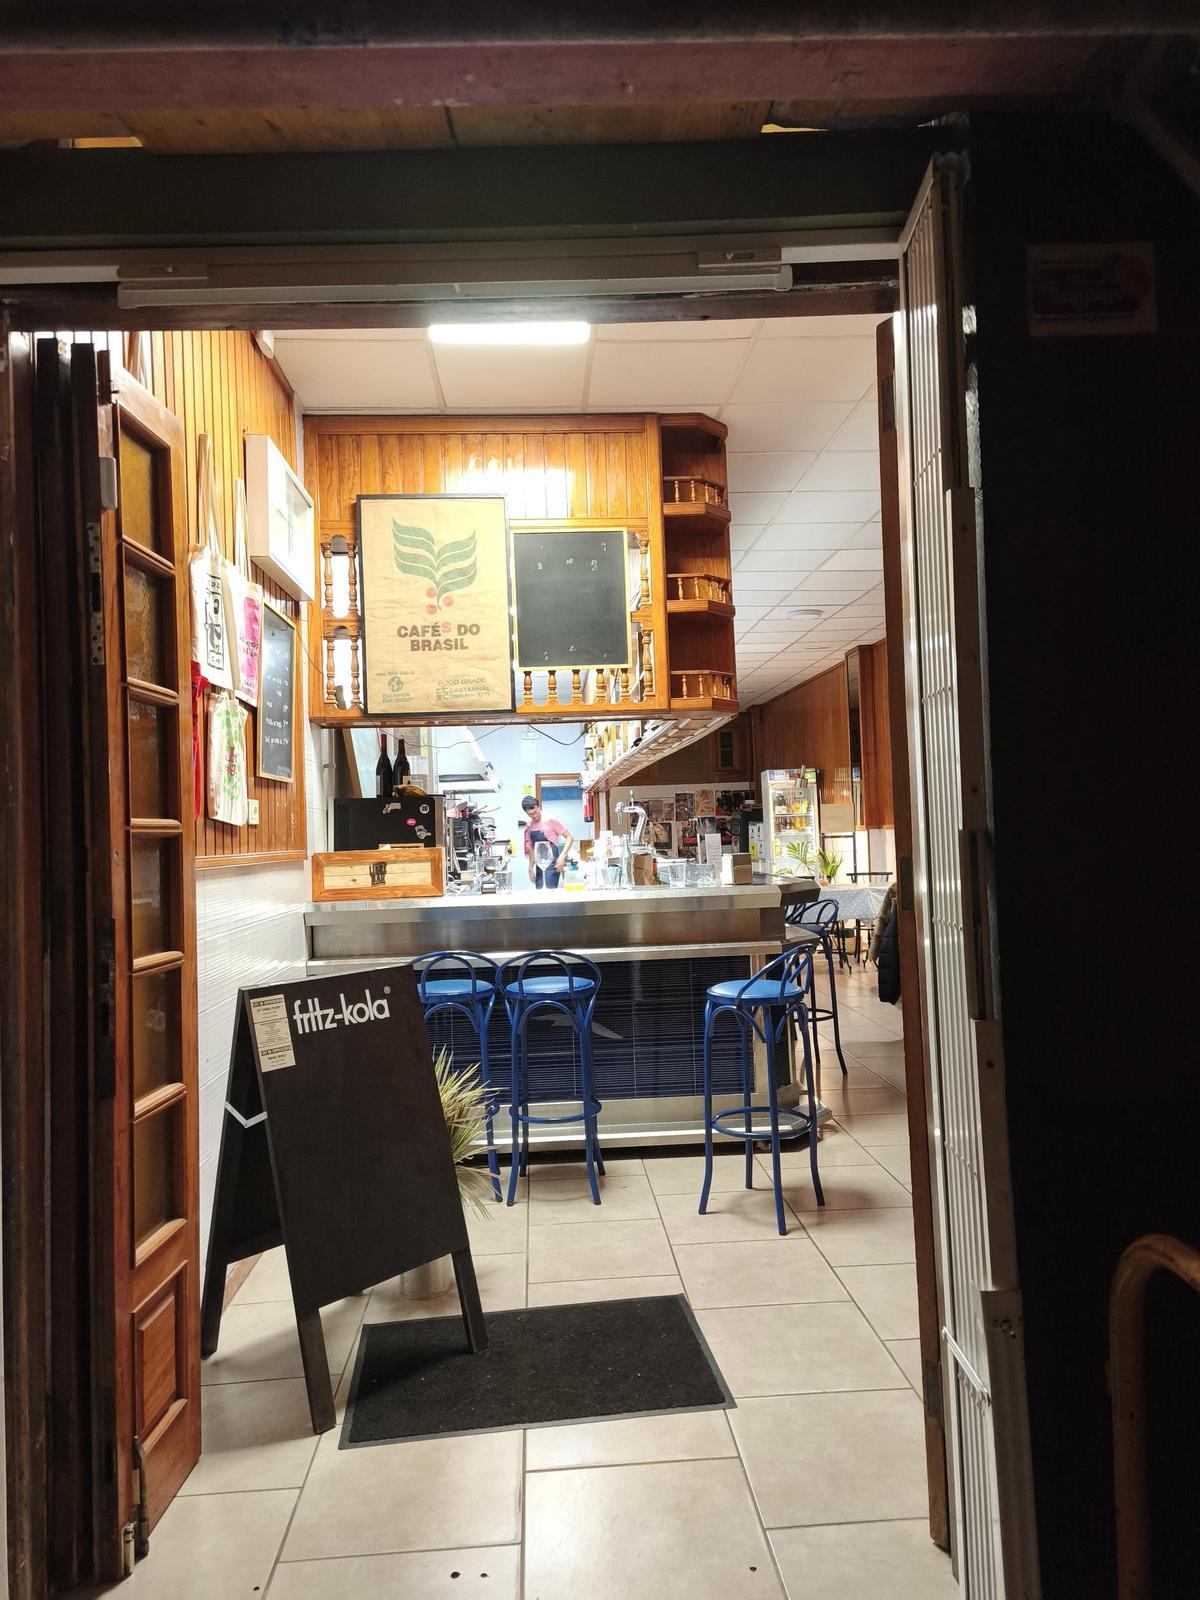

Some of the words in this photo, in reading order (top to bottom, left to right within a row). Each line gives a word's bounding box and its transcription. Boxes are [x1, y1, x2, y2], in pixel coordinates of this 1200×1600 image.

[397, 621, 452, 638] CAFÉS
[457, 623, 481, 636] DO
[410, 638, 469, 652] BRASIL
